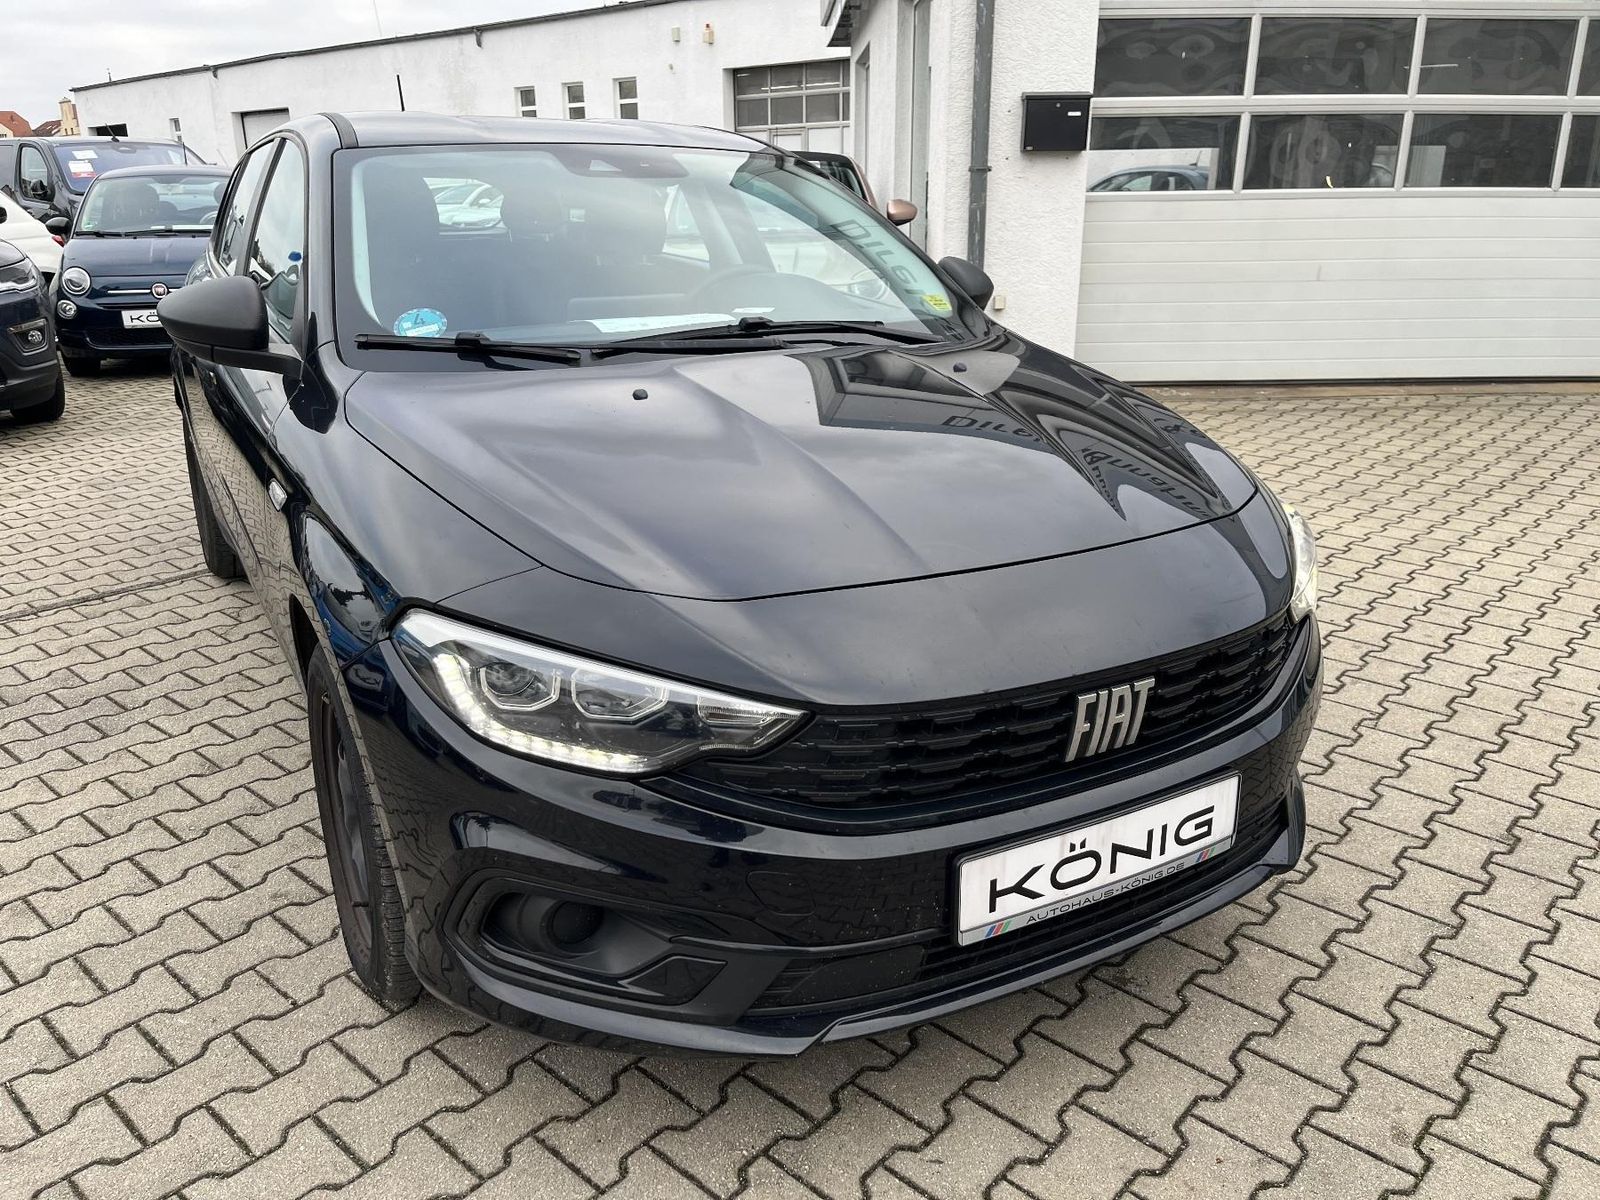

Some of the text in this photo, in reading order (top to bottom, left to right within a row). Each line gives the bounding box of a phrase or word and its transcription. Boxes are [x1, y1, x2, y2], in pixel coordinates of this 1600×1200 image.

[130, 311, 161, 324] KÖ
[1064, 678, 1156, 762] FIAT
[988, 805, 1215, 913] KÖNIG
[1026, 862, 1185, 924] AUTOHAUS-KÖNIG.DE
